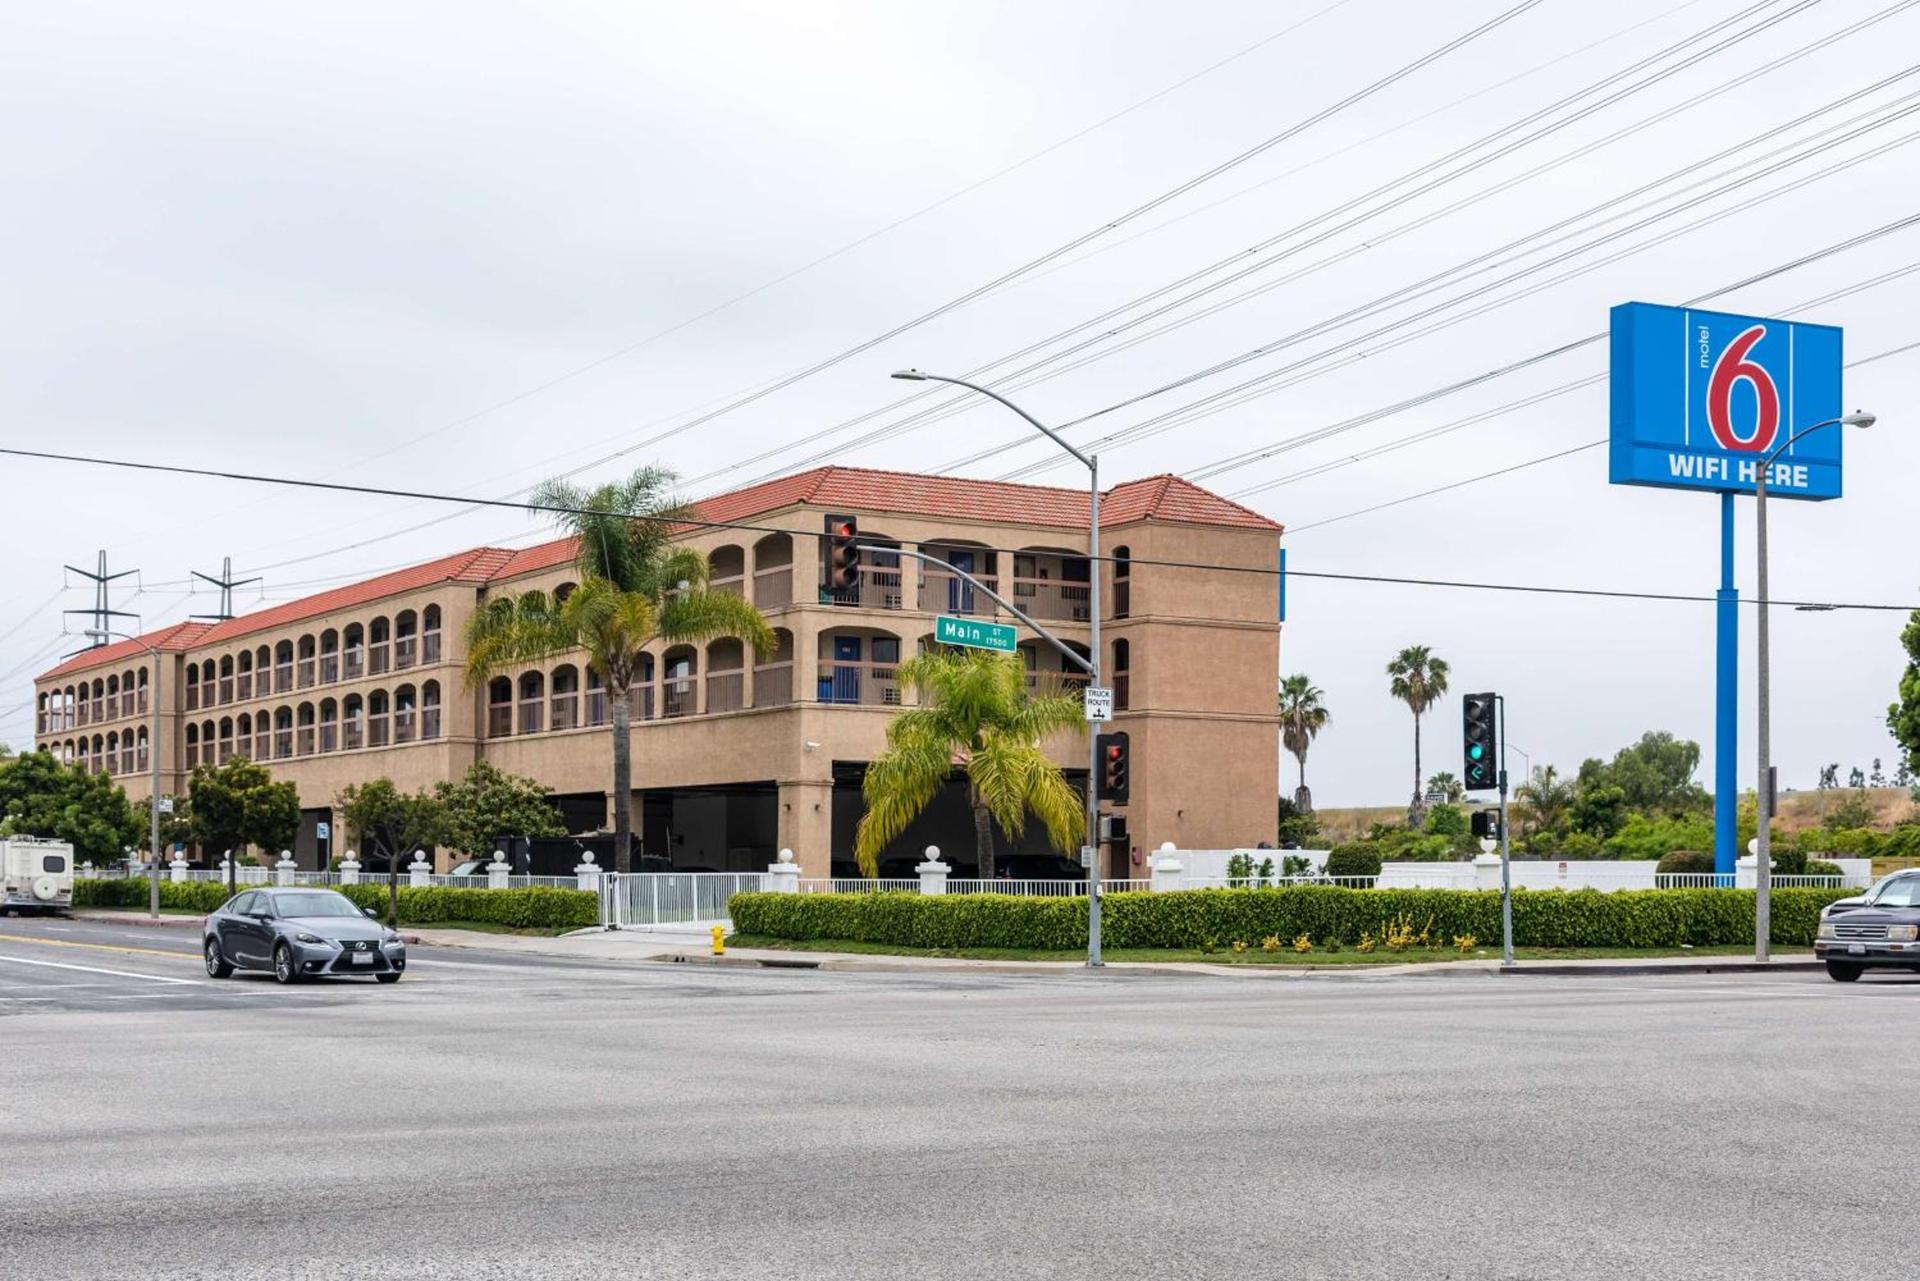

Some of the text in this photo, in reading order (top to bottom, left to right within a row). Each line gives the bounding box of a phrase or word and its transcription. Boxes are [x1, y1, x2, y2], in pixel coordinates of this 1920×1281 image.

[1698, 326, 1709, 368] motel
[1706, 324, 1780, 453] 6
[1669, 454, 1728, 480] WIFI
[945, 623, 980, 640] Main
[986, 637, 1007, 647] 17500
